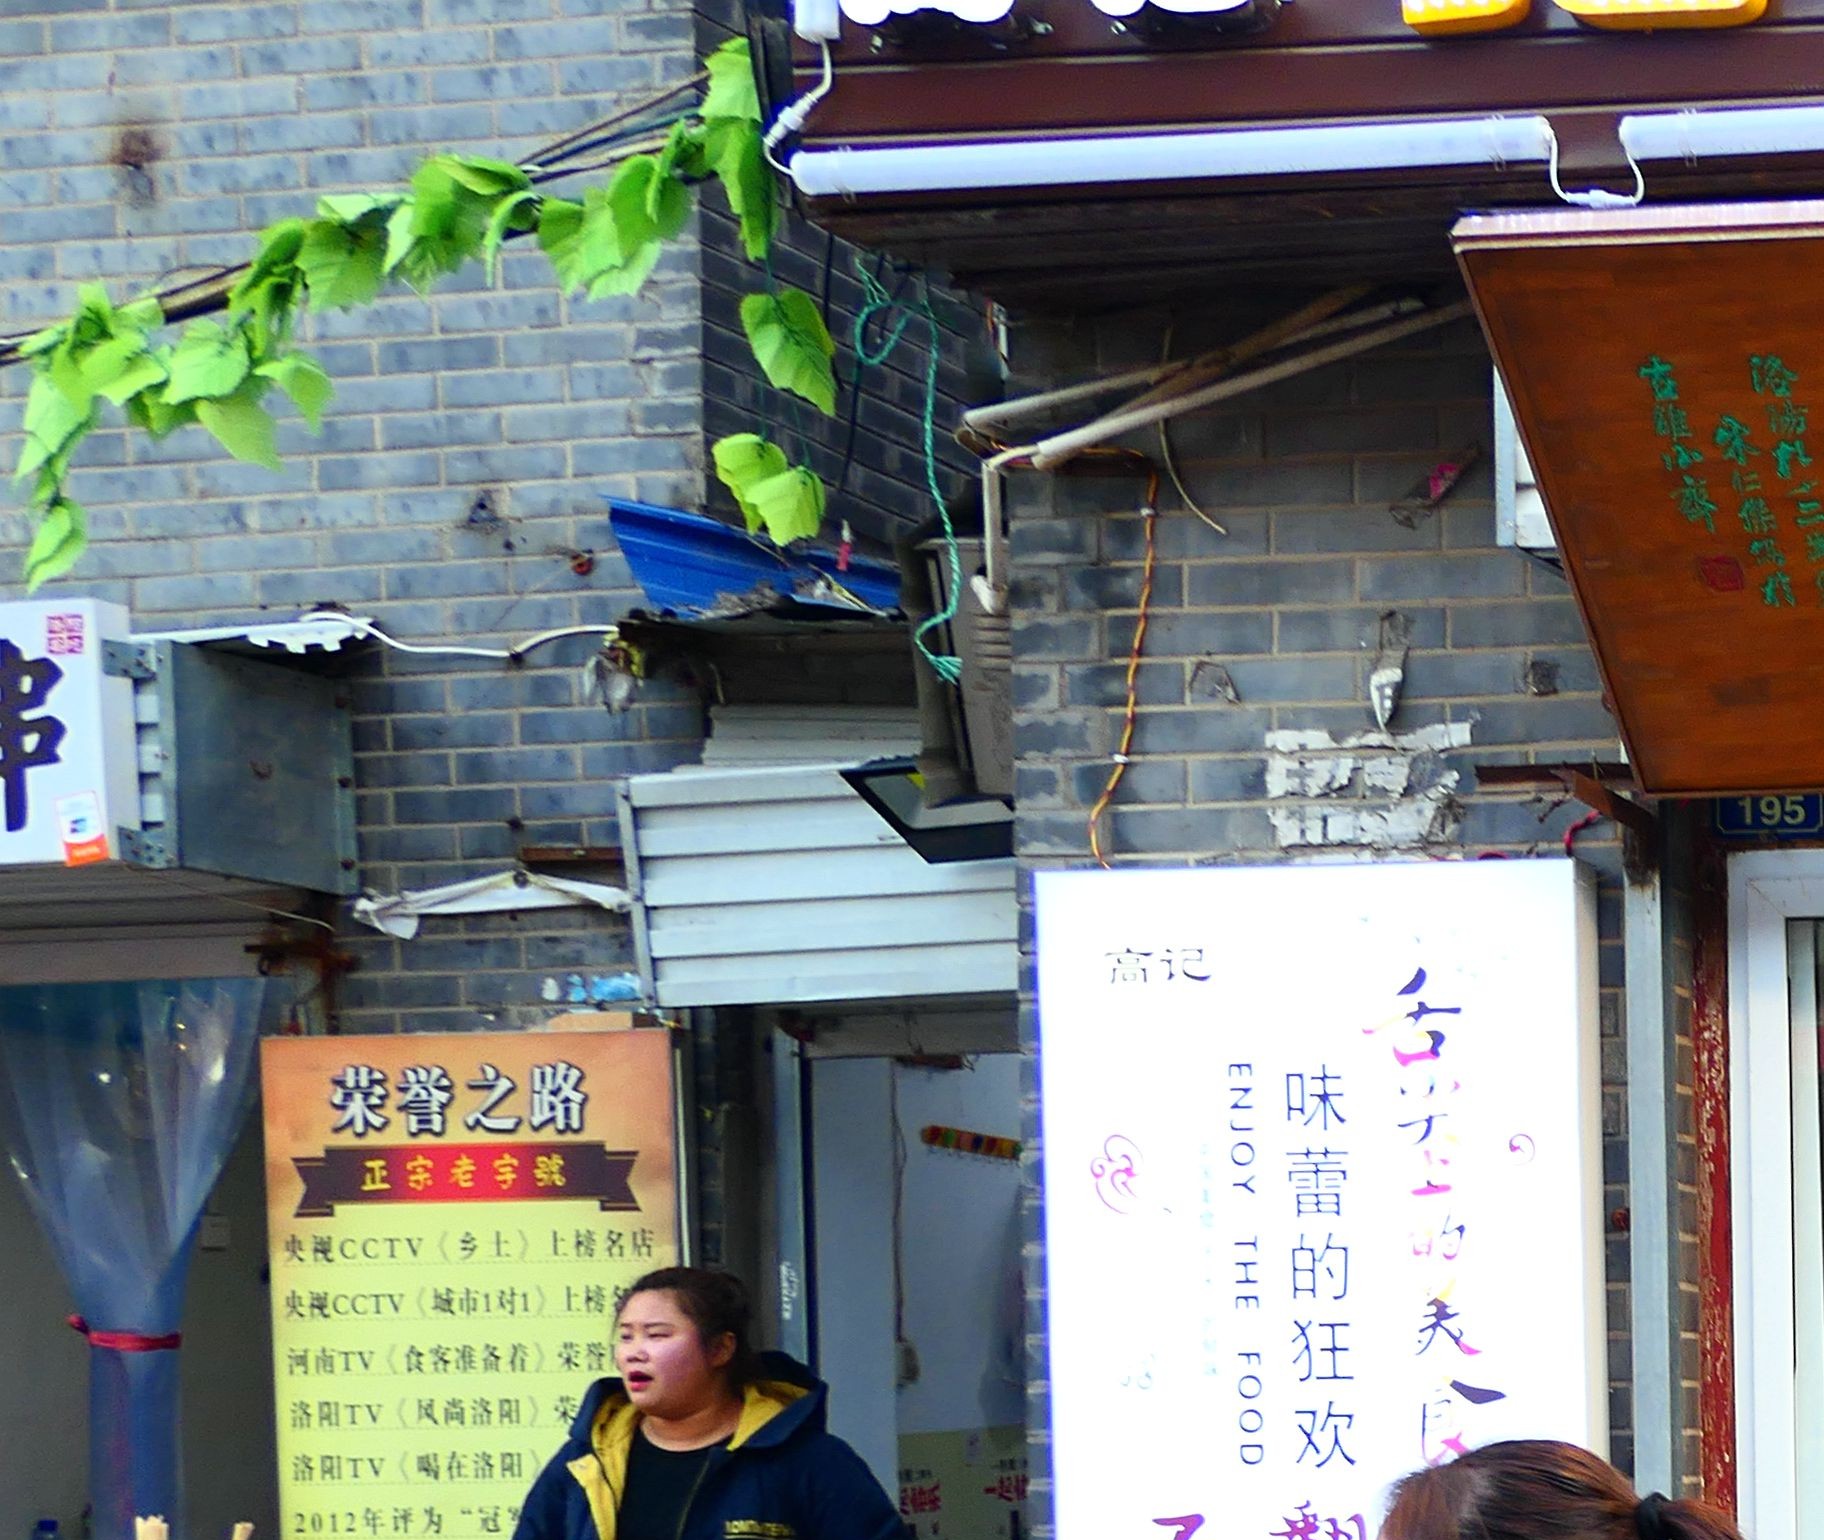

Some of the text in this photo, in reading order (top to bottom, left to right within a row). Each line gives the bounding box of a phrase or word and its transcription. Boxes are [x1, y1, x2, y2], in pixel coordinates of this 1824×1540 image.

[1738, 796, 1806, 826] 195
[331, 1062, 590, 1138] 荣誉之路
[1227, 1062, 1265, 1467] ENJOY THE FOOD
[1285, 1063, 1357, 1469] 味蕾的狂欢
